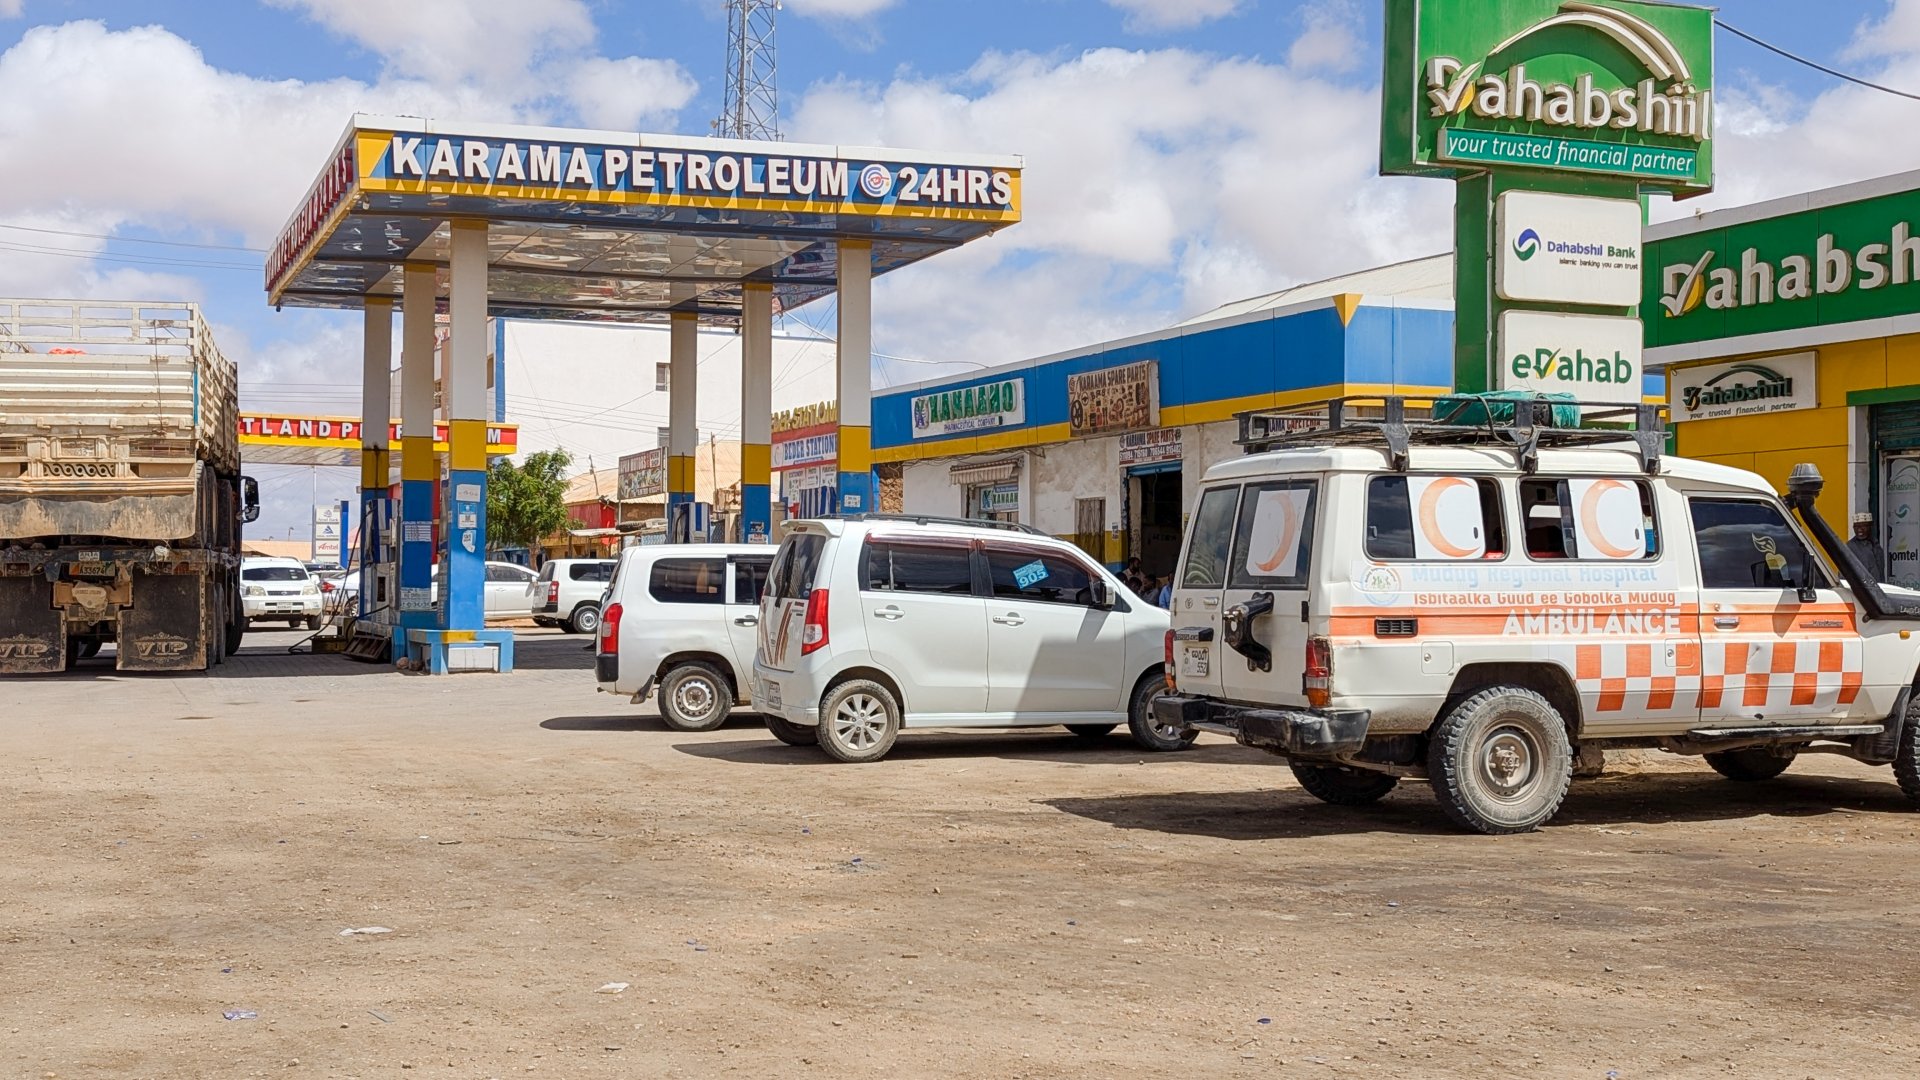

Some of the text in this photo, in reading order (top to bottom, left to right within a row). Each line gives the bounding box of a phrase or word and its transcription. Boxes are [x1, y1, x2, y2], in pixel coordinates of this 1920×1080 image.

[1427, 56, 1712, 142] Dahabshiil
[1448, 136, 1693, 172] your trusted financial partner
[392, 136, 1012, 205] KARAMA PETROLEUM 24HRS
[1607, 246, 1636, 259] Bank
[1580, 259, 1600, 268] banking
[1107, 368, 1126, 387] SPARE
[1126, 364, 1146, 383] PARTS
[1512, 348, 1632, 384] eDahab
[1682, 377, 1793, 411] Dahabshiil
[1708, 408, 1731, 416] trusted
[1736, 405, 1766, 415] financial
[1771, 403, 1797, 412] partner
[977, 417, 996, 427] COMPANY
[1018, 570, 1046, 587] 905
[1412, 566, 1478, 588] Mudug
[1488, 567, 1571, 588] Regional
[1580, 567, 1658, 588] Hospital
[1414, 592, 1491, 605] Isbitaalka
[1540, 594, 1558, 605] ee
[1628, 592, 1675, 606] Mudug
[1502, 608, 1681, 635] AMBULANCE
[0, 642, 49, 659] VIP
[134, 640, 188, 657] VIP
